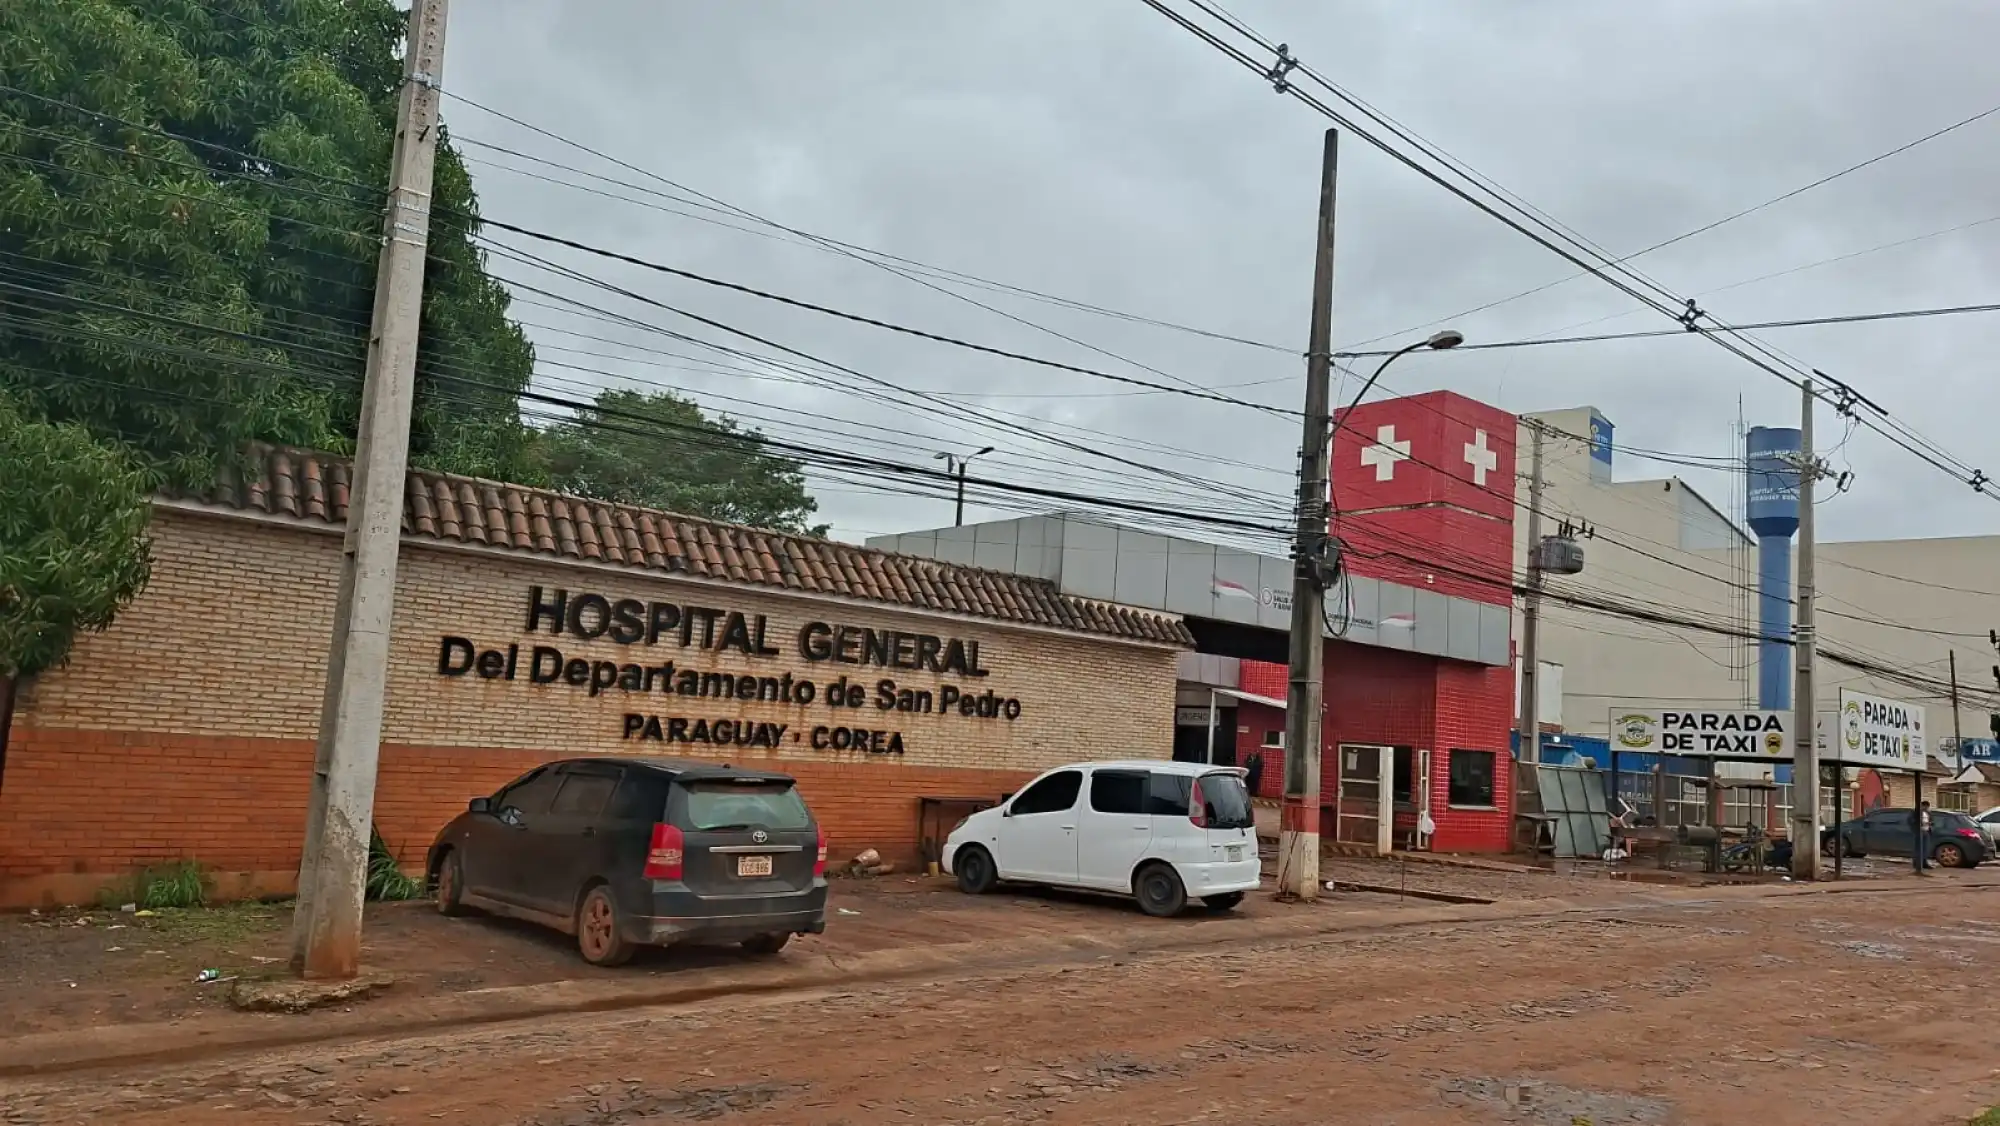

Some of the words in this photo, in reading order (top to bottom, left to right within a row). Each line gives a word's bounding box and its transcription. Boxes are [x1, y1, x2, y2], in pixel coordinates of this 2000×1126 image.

[525, 585, 780, 657] HOSPITAL
[798, 621, 990, 677] GENERAL
[438, 636, 518, 681] Del
[529, 645, 816, 705] Departamento
[825, 675, 866, 708] de
[874, 679, 932, 713] San
[938, 684, 1022, 720] Pedro
[1662, 712, 1784, 733] PARADA
[1864, 701, 1910, 731] PARADA
[622, 713, 788, 748] PARAGUAY
[810, 725, 905, 754] COREA
[1662, 733, 1694, 750] DE
[1703, 734, 1757, 753] TAXI
[1864, 732, 1878, 755] DE
[1880, 734, 1901, 758] TAXI
